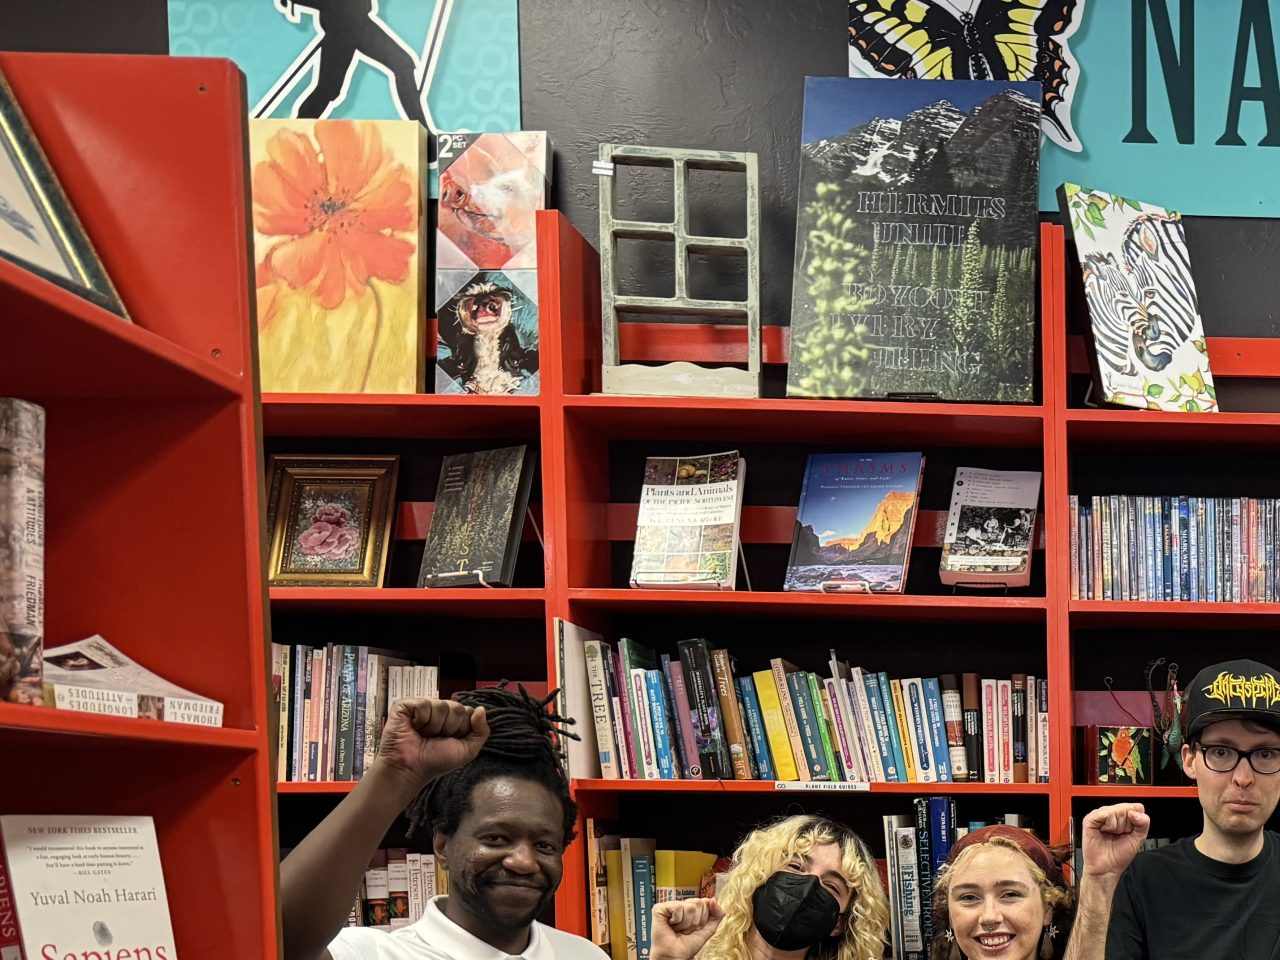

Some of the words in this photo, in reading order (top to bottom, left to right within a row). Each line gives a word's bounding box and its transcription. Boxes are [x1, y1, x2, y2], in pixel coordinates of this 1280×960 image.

[856, 190, 1007, 220] HERMITS
[871, 345, 984, 374] THING
[645, 487, 675, 497] Plants
[675, 487, 694, 497] and
[694, 484, 734, 497] Animals
[26, 574, 37, 627] FRIEDMAN
[343, 652, 356, 683] PLANTS
[68, 687, 125, 702] ATTITUDES
[342, 684, 352, 695] OF
[592, 678, 607, 726] TREE
[69, 699, 134, 716] LONGITUDES
[169, 699, 221, 714] FRIEDMAN
[340, 695, 353, 733] ARIZONA
[69, 826, 92, 835] TIMES
[93, 826, 139, 835] BESTSELLER
[918, 831, 931, 897] SELECTIVE
[30, 889, 70, 907] Yuval
[73, 889, 111, 905] Noah
[114, 887, 157, 903] Harari
[411, 868, 420, 901] Peterson
[902, 870, 915, 917] Fishing
[921, 897, 934, 940] TROUT
